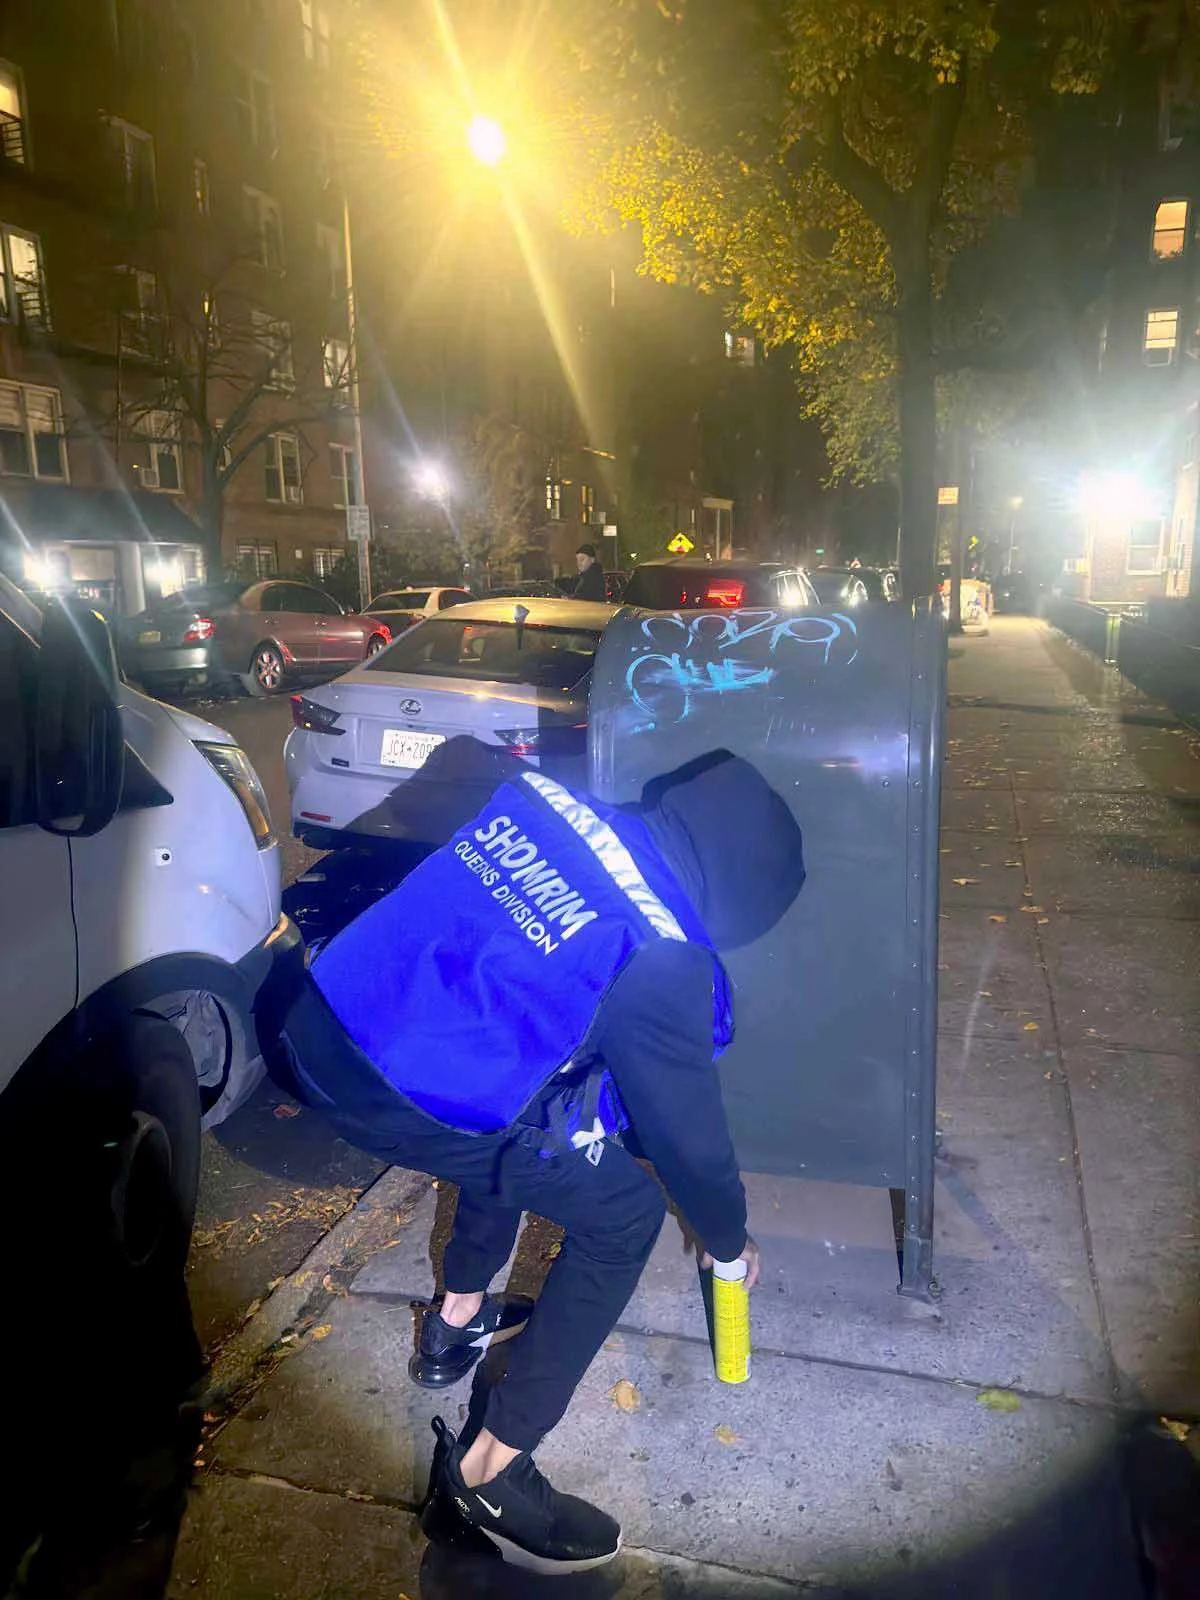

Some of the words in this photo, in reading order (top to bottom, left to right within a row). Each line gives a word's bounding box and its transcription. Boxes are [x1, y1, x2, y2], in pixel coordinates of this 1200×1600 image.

[454, 840, 500, 886] QUEENS
[491, 885, 560, 955] DIVISION
[474, 815, 598, 941] SHOMRIM
